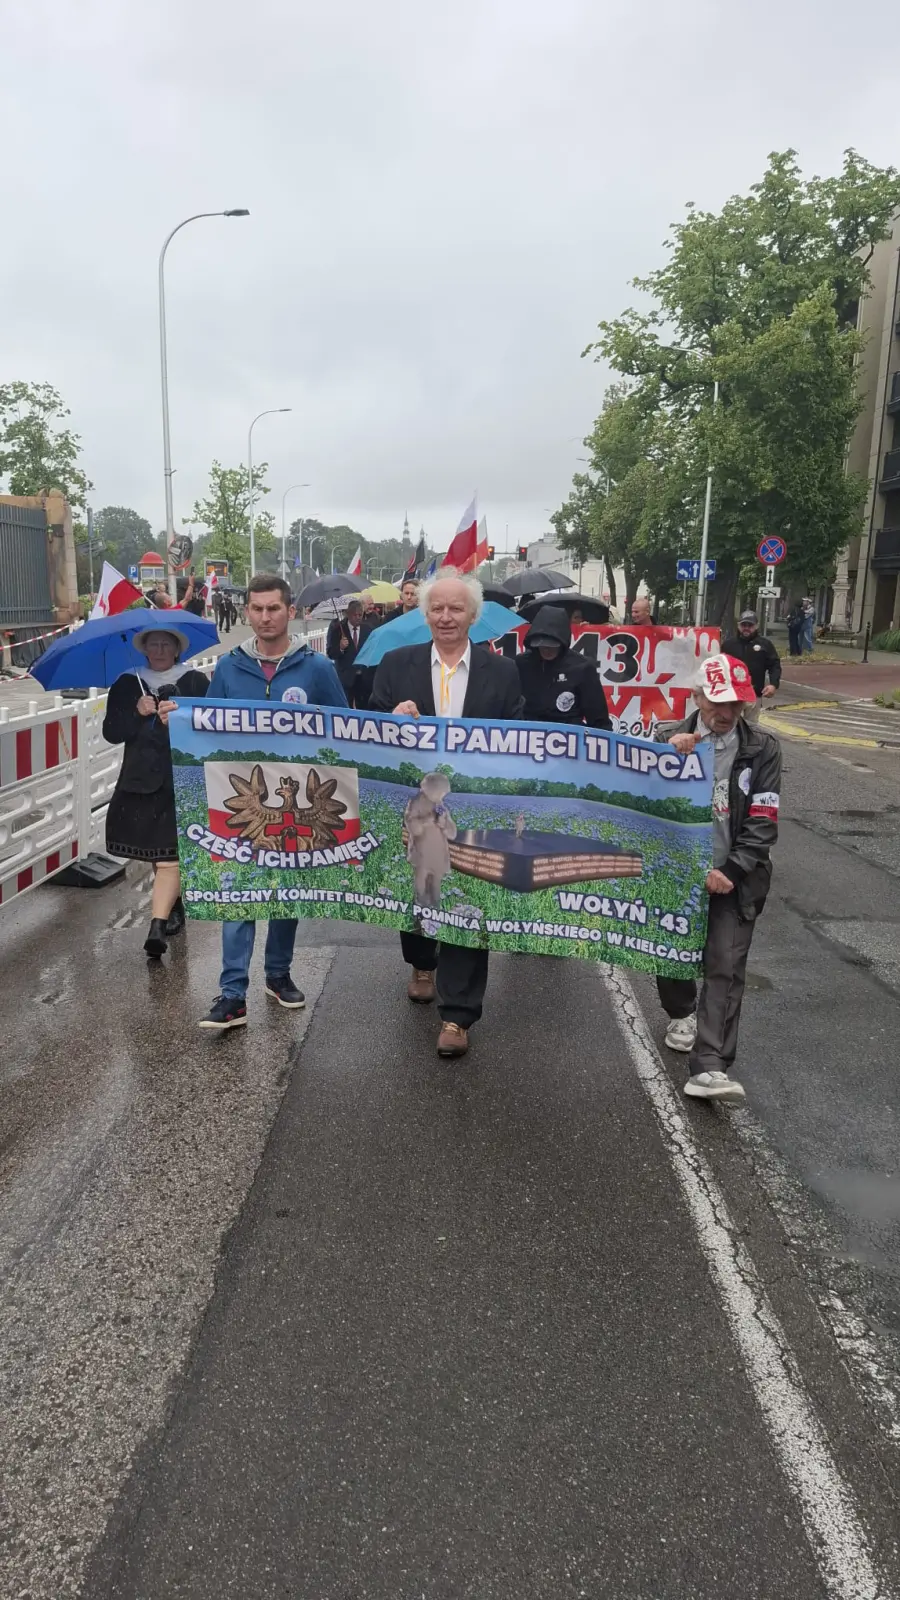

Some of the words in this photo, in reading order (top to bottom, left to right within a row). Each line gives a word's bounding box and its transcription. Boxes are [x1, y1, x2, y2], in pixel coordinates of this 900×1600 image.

[492, 632, 641, 683] 143
[192, 706, 325, 738] KIELECKI
[333, 718, 438, 751] MARSZ
[446, 725, 577, 763] PAMIĘCI
[585, 735, 610, 764] 11
[617, 742, 705, 781] LIPCA
[186, 822, 253, 864] CZEŚĆ
[257, 850, 296, 868] ICH
[298, 832, 380, 868] PAMIĘCI
[185, 889, 273, 903] SPOŁECZNY
[276, 888, 344, 903] KOMITET
[345, 893, 409, 914] BUDOWY
[412, 904, 481, 932] POMNIKA
[486, 918, 602, 942] WOŁYŃSKIEGO
[606, 932, 623, 946] W
[624, 936, 703, 963] KIELCACH
[558, 891, 648, 925] WOŁYŃ
